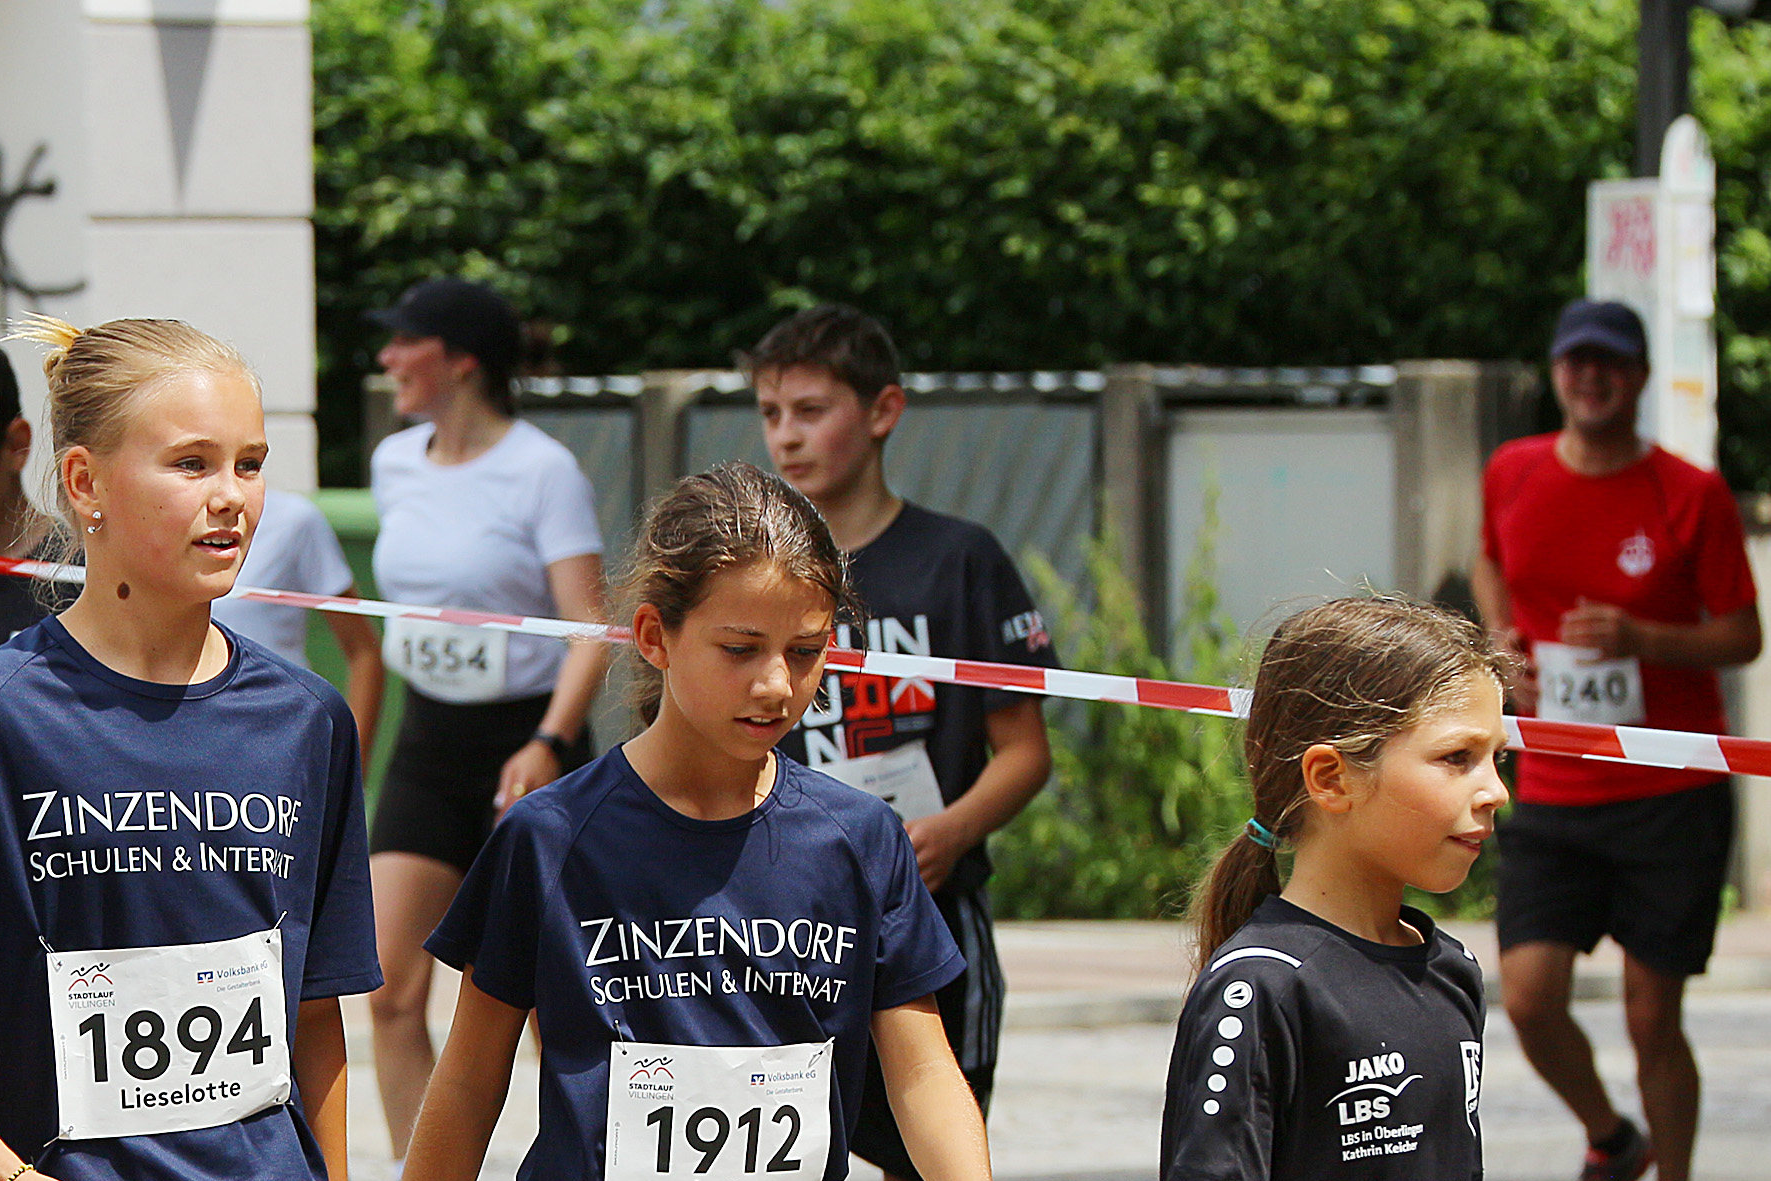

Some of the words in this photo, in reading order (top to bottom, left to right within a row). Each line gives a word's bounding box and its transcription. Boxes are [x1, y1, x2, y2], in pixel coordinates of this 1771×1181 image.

[23, 791, 301, 841] ZINZENDORF
[29, 847, 162, 882] SCHULEN
[172, 847, 192, 872] &
[580, 917, 857, 967] ZINZENDORF
[217, 962, 259, 978] Volksbank
[68, 991, 114, 1000] STADTLAUF
[590, 970, 712, 1005] SCHULEN
[721, 970, 738, 994] &
[68, 999, 116, 1009] VILLINGEN
[79, 997, 271, 1082] 1894
[1344, 1051, 1406, 1083] JAKO
[121, 1081, 241, 1109] Lieselotte
[628, 1082, 674, 1091] STADTLAUF
[628, 1090, 674, 1100] VILLINGEN
[1338, 1095, 1391, 1126] LBS
[646, 1104, 802, 1174] 1912
[1341, 1132, 1361, 1147] LBS
[1361, 1130, 1373, 1142] in
[1342, 1145, 1383, 1162] Kathrin
